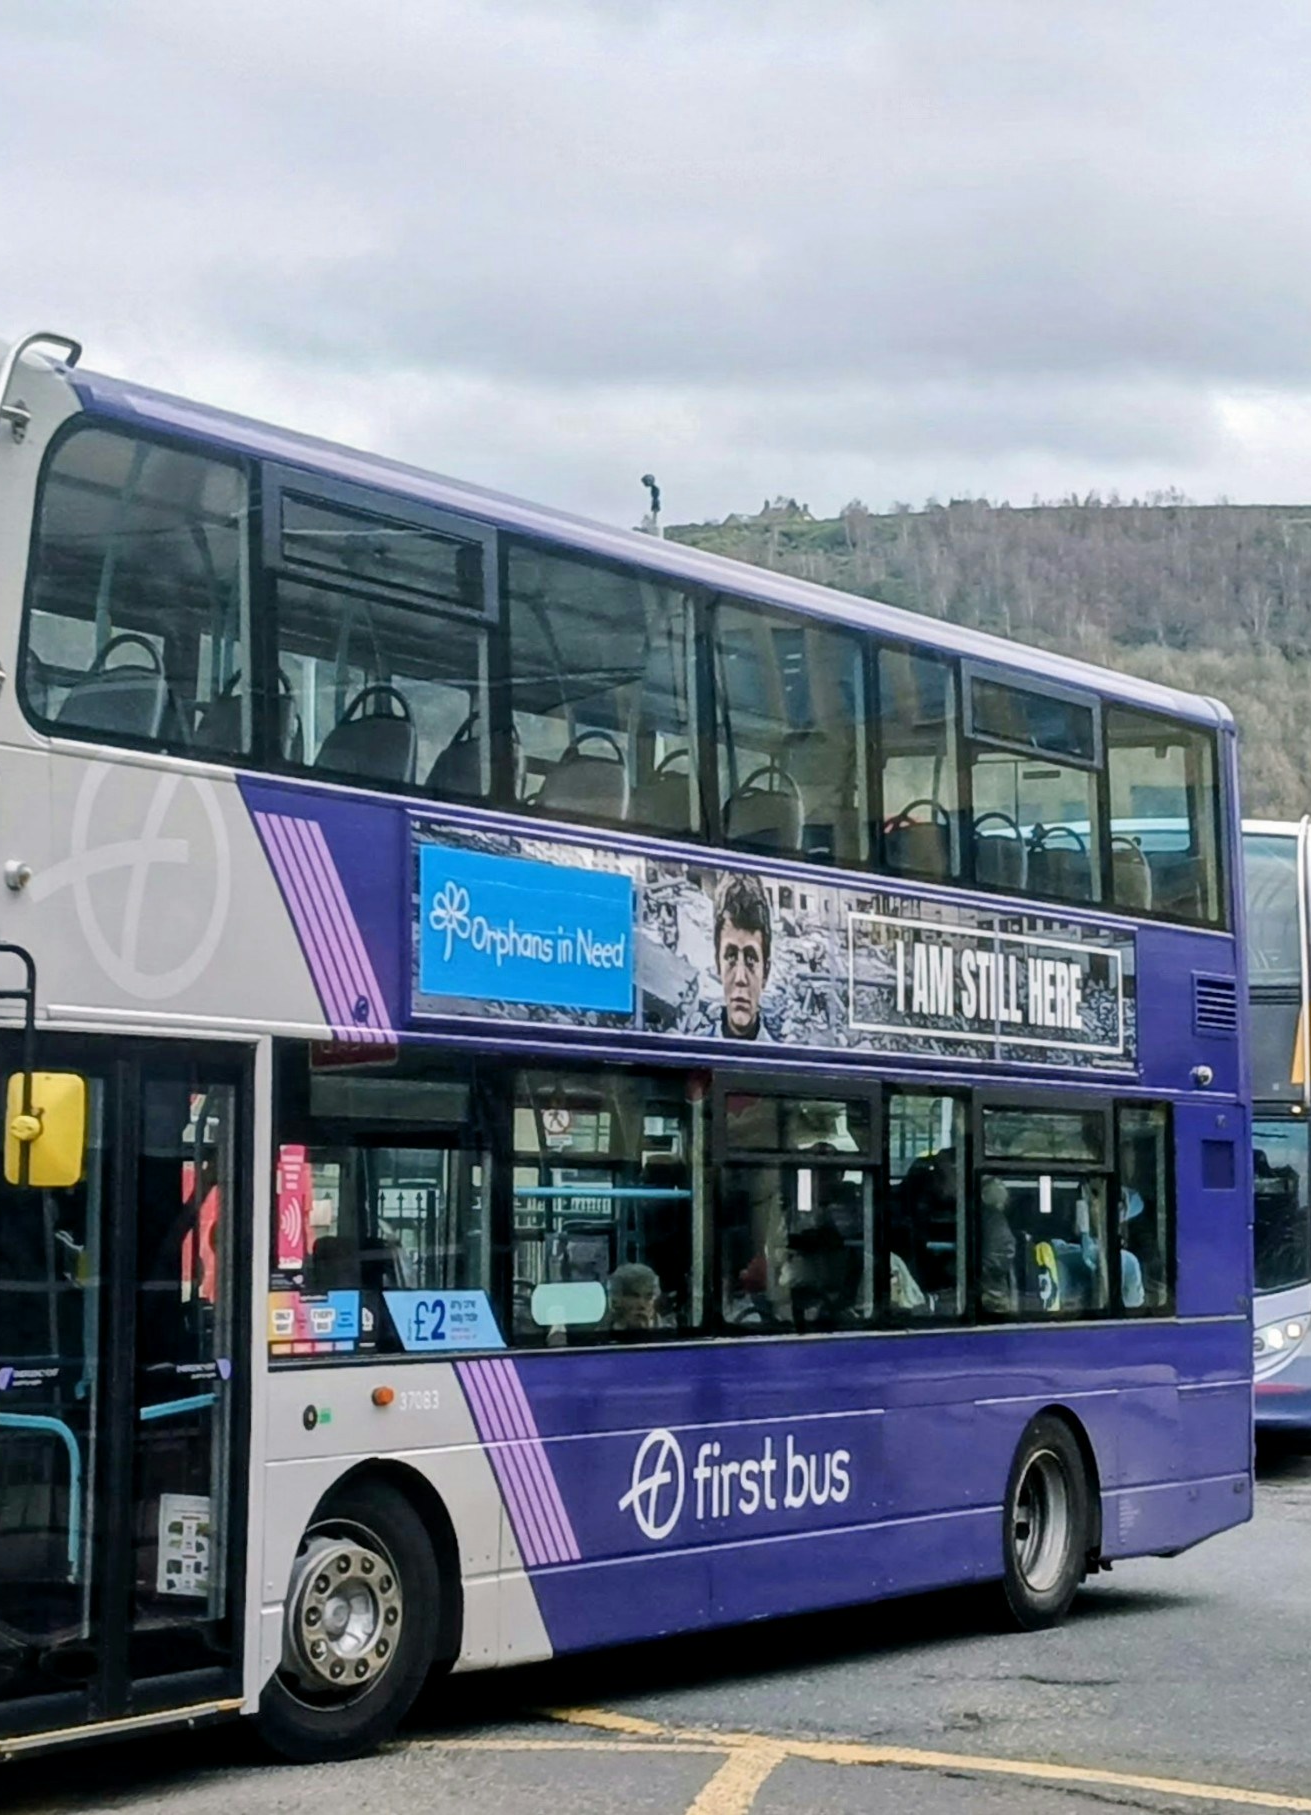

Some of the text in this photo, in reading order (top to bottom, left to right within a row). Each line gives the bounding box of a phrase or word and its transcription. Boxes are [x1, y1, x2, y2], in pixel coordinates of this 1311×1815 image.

[471, 915, 626, 968] Orphans in Need
[896, 939, 1083, 1030] I AM STILL HERE
[413, 1298, 446, 1341] £2
[399, 1389, 440, 1411] 37083
[693, 1434, 851, 1520] first bus
